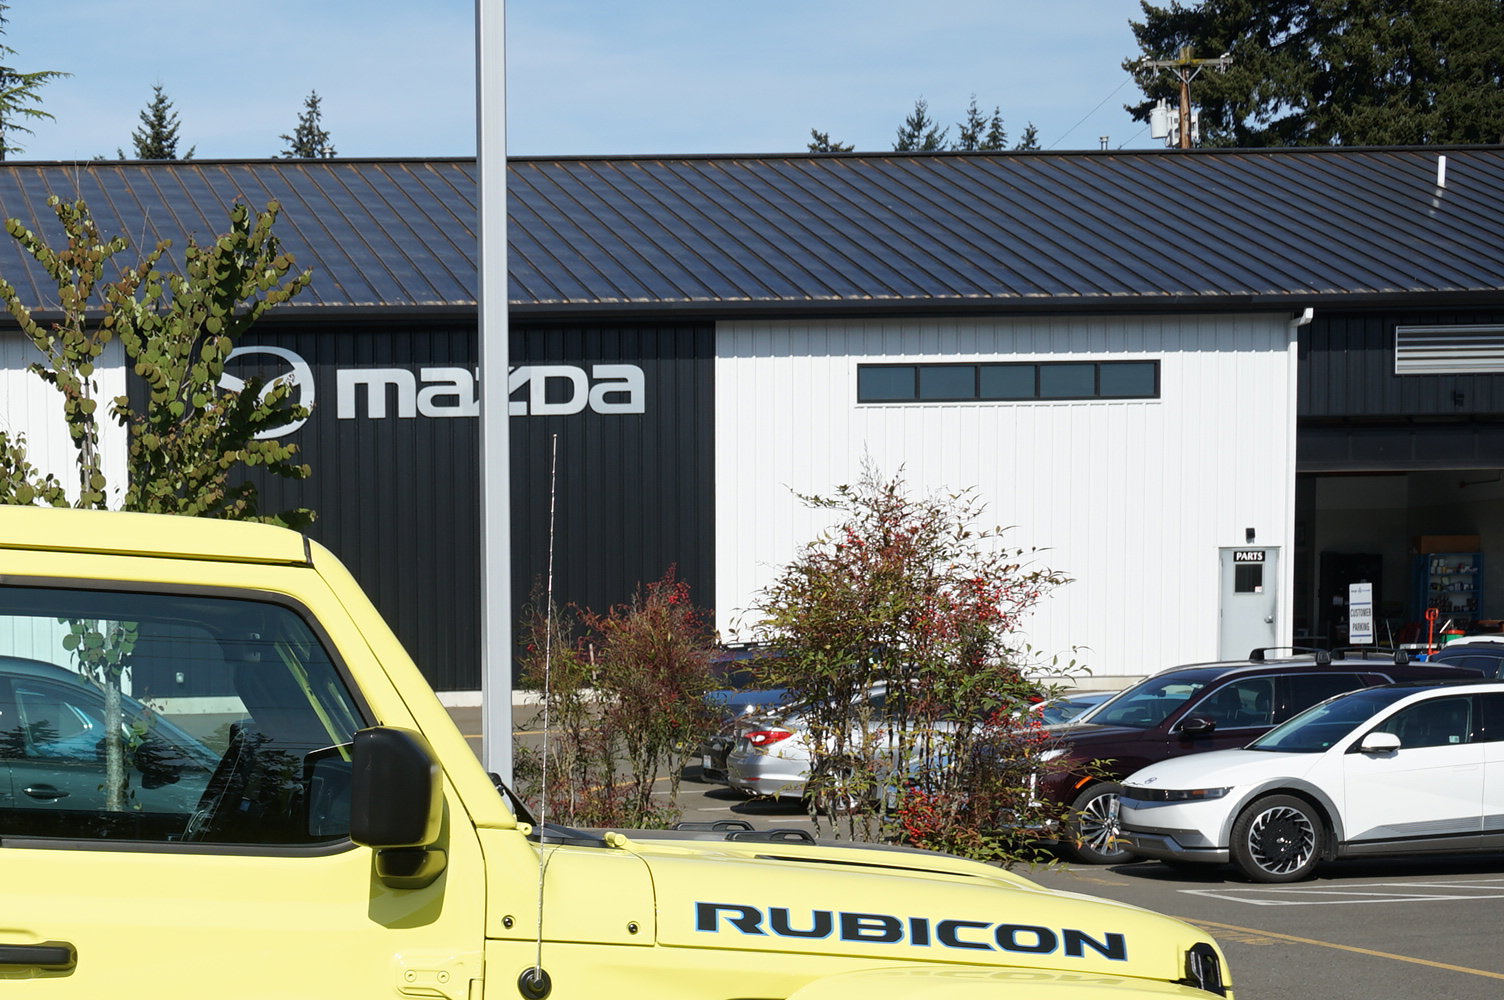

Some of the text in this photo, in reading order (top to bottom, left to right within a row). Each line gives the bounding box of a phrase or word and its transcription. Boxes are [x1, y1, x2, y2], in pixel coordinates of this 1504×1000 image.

[1236, 551, 1263, 561] PARTS
[1351, 607, 1371, 617] CUSTOMER
[1352, 622, 1370, 631] PARKING
[695, 901, 1128, 962] RUBICON
